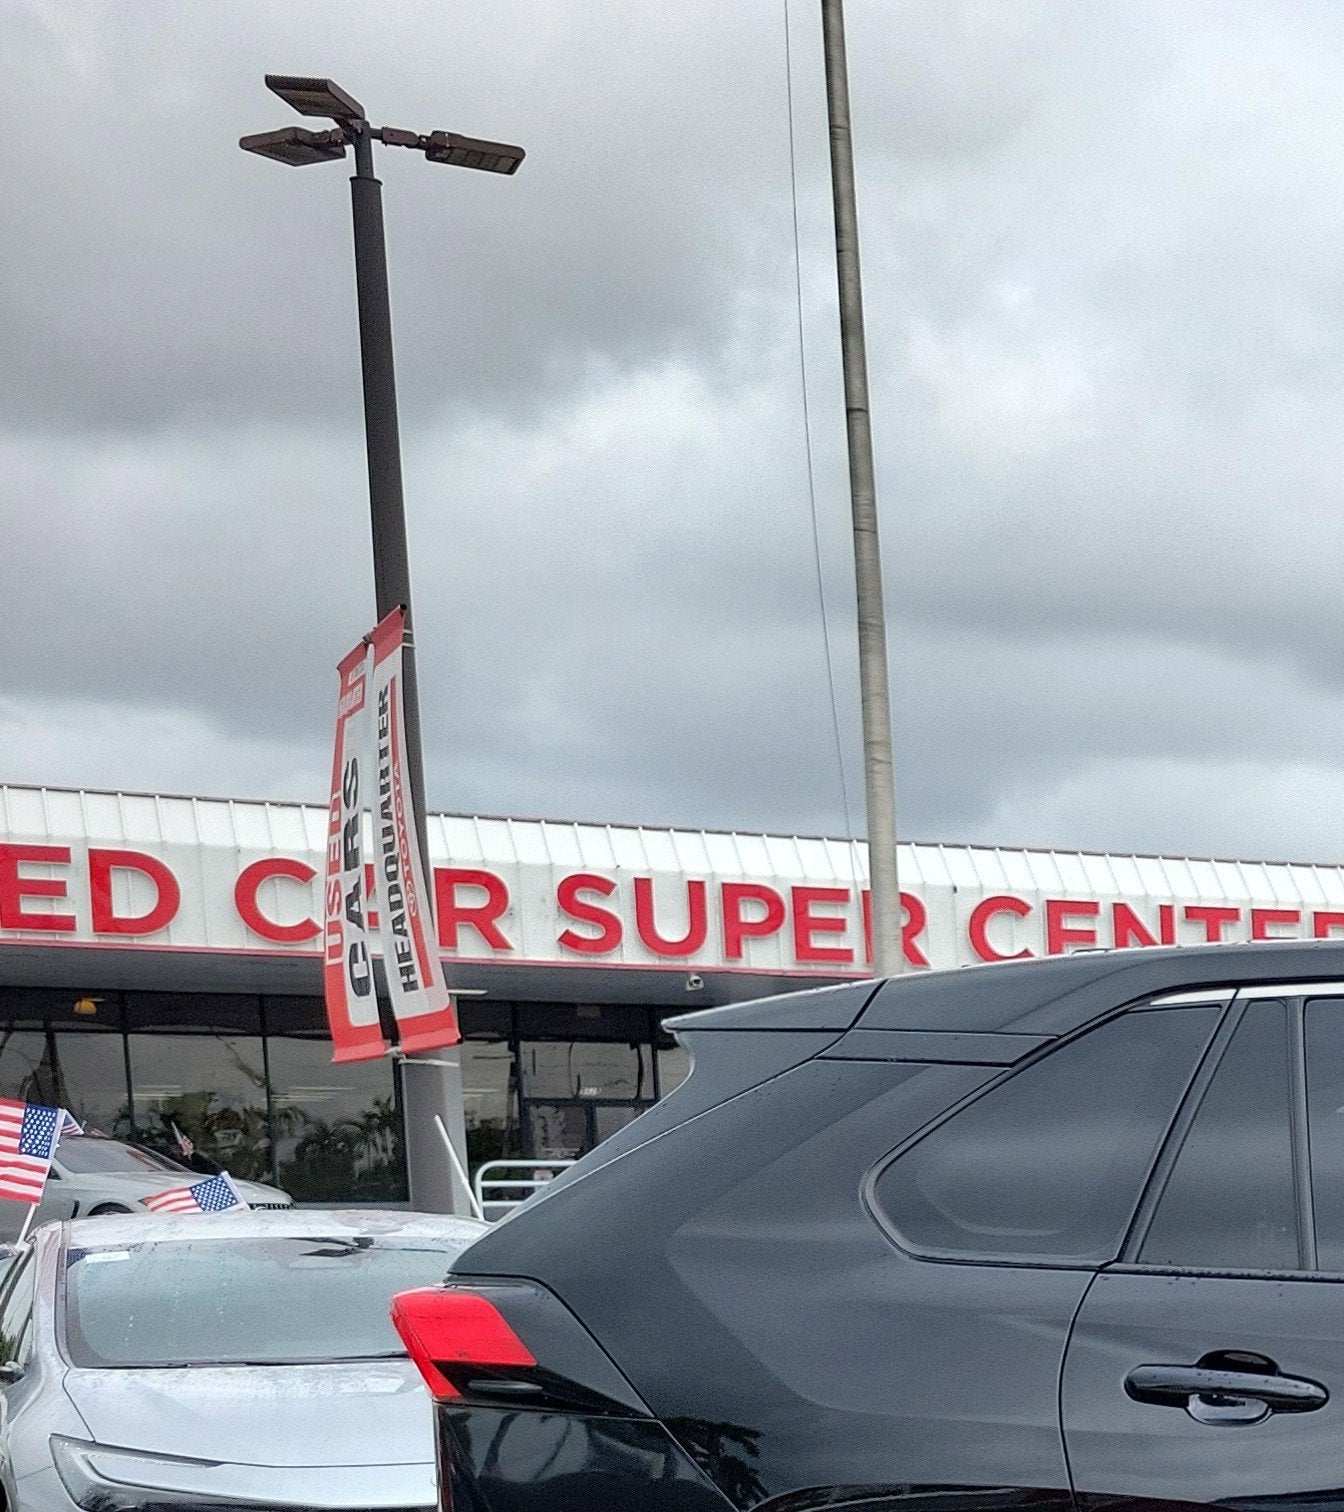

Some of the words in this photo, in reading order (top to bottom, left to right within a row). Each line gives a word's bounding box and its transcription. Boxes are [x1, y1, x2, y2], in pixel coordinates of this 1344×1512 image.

[326, 795, 344, 960] USED
[343, 757, 372, 998] CARS
[378, 684, 420, 994] HEADQUARTER
[393, 760, 410, 875] TOYOTA
[0, 843, 181, 935] ED
[234, 857, 513, 950] CR
[556, 873, 929, 967] SUPER
